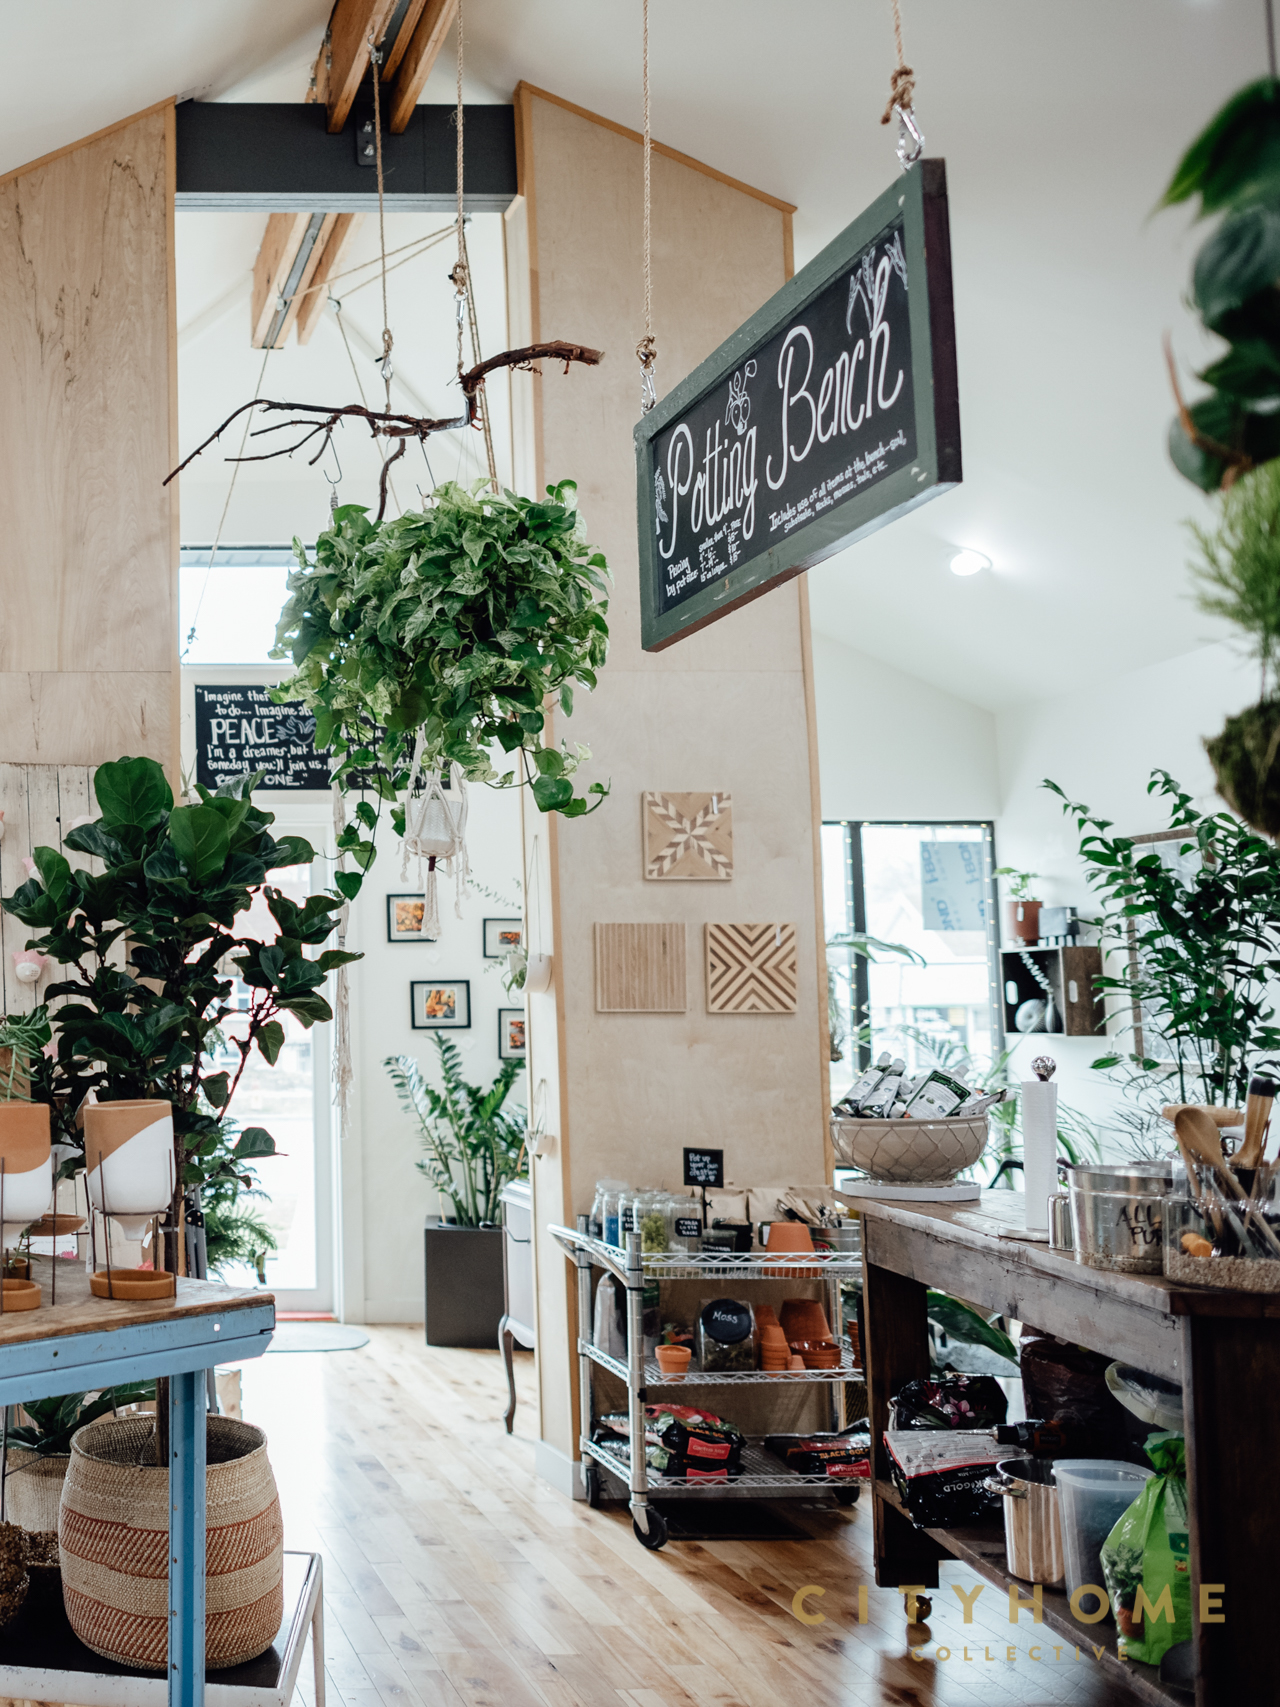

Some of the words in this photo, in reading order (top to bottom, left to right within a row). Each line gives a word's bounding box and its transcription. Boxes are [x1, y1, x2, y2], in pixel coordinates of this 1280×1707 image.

[659, 420, 758, 559] Potting
[766, 255, 904, 490] Bench
[769, 503, 797, 532] Includes
[797, 497, 810, 512] use
[809, 487, 818, 503] of
[818, 481, 827, 498] all
[826, 478, 845, 491] items
[853, 456, 866, 474] the
[665, 584, 676, 597] by
[215, 703, 228, 716] to
[255, 704, 298, 721] Imagine
[209, 717, 279, 746] PEACE
[207, 744, 224, 759] I'm
[229, 747, 237, 759] a
[287, 760, 307, 775] join
[1116, 1205, 1162, 1227] ALL
[820, 1450, 847, 1459] BLACK
[943, 1481, 971, 1493] GOLD
